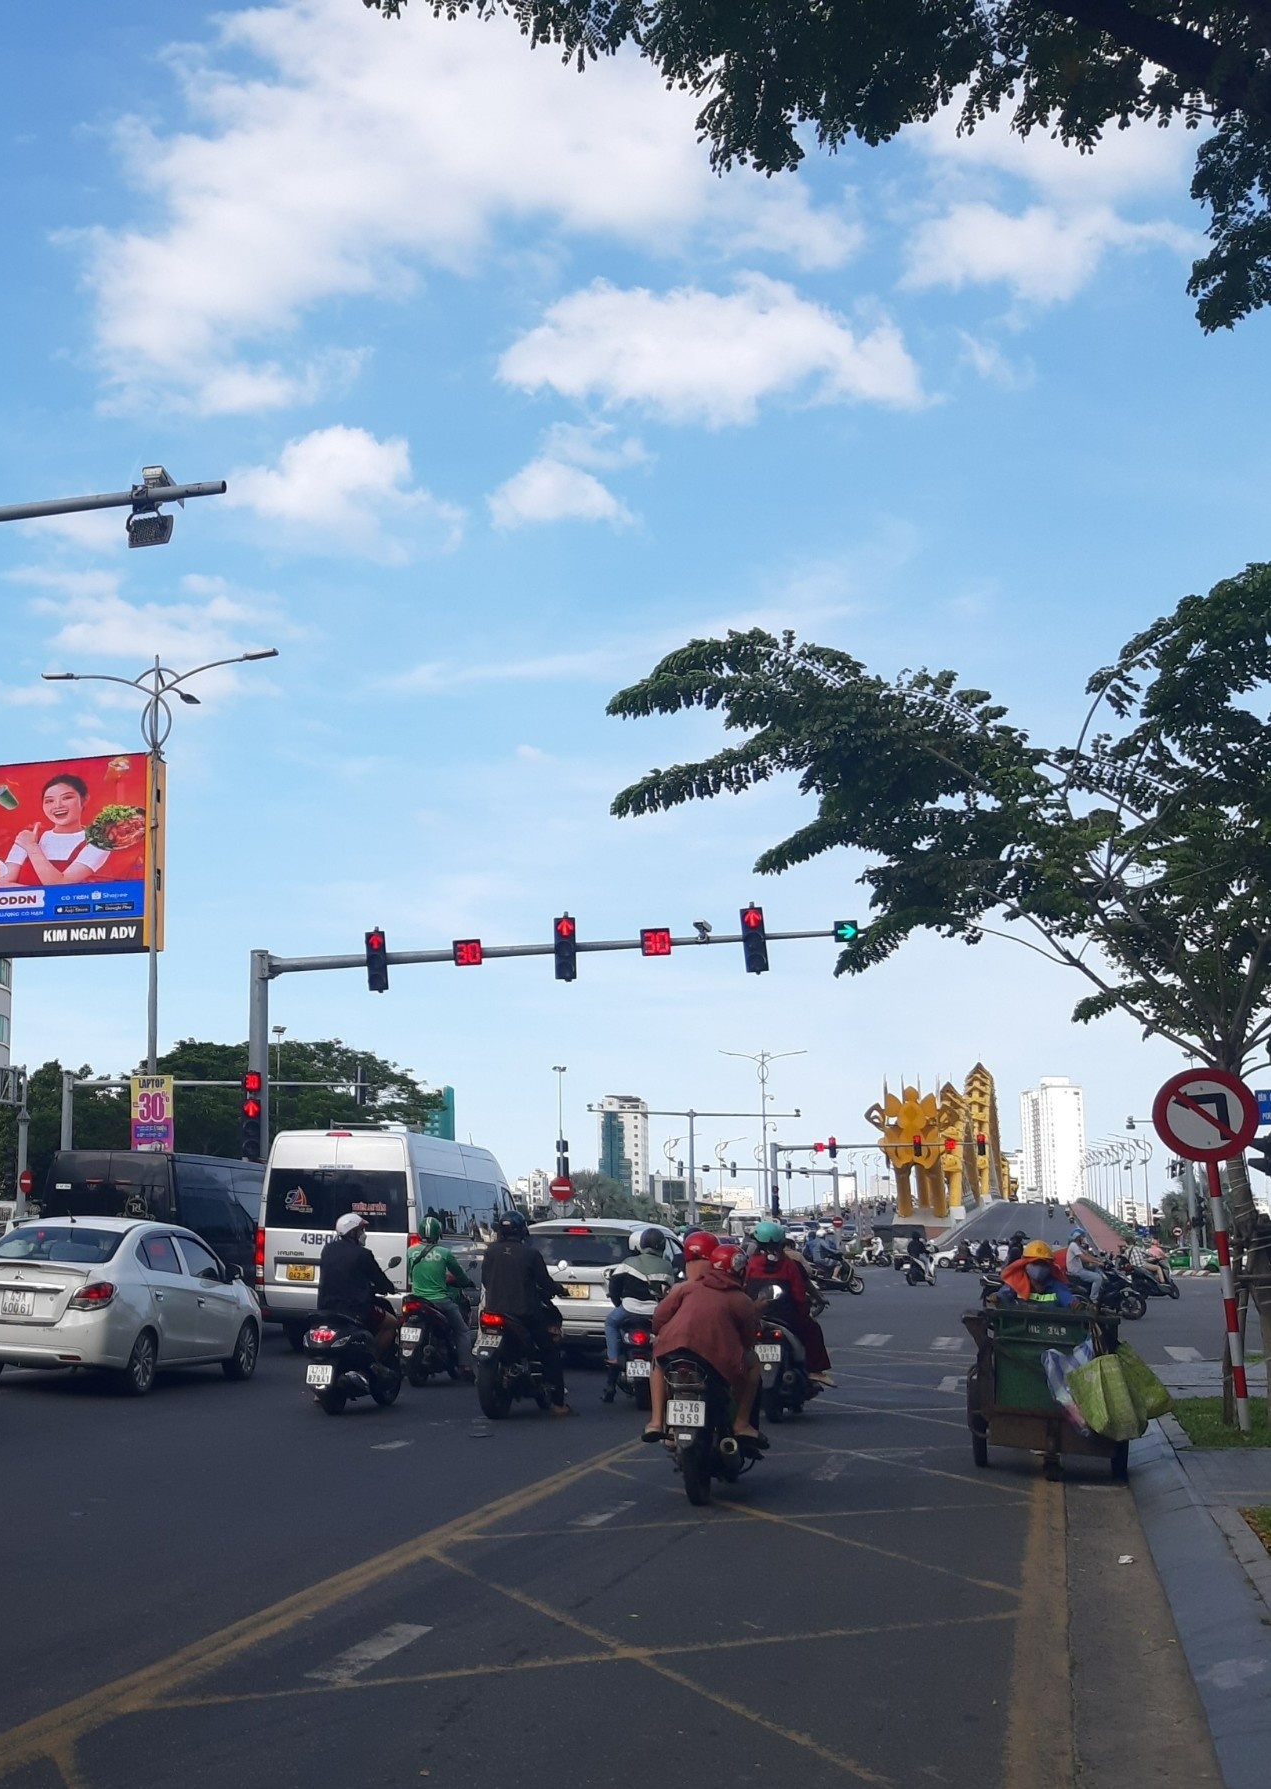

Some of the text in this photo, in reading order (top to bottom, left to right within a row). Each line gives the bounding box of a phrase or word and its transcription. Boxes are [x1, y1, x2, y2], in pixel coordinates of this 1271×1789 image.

[43, 926, 137, 942] KIM NGAN ADV
[645, 932, 669, 954] 30
[457, 942, 480, 964] 30
[139, 1079, 165, 1089] LAPTOP
[412, 1250, 442, 1261] Gab
[673, 1413, 700, 1424] 1959
